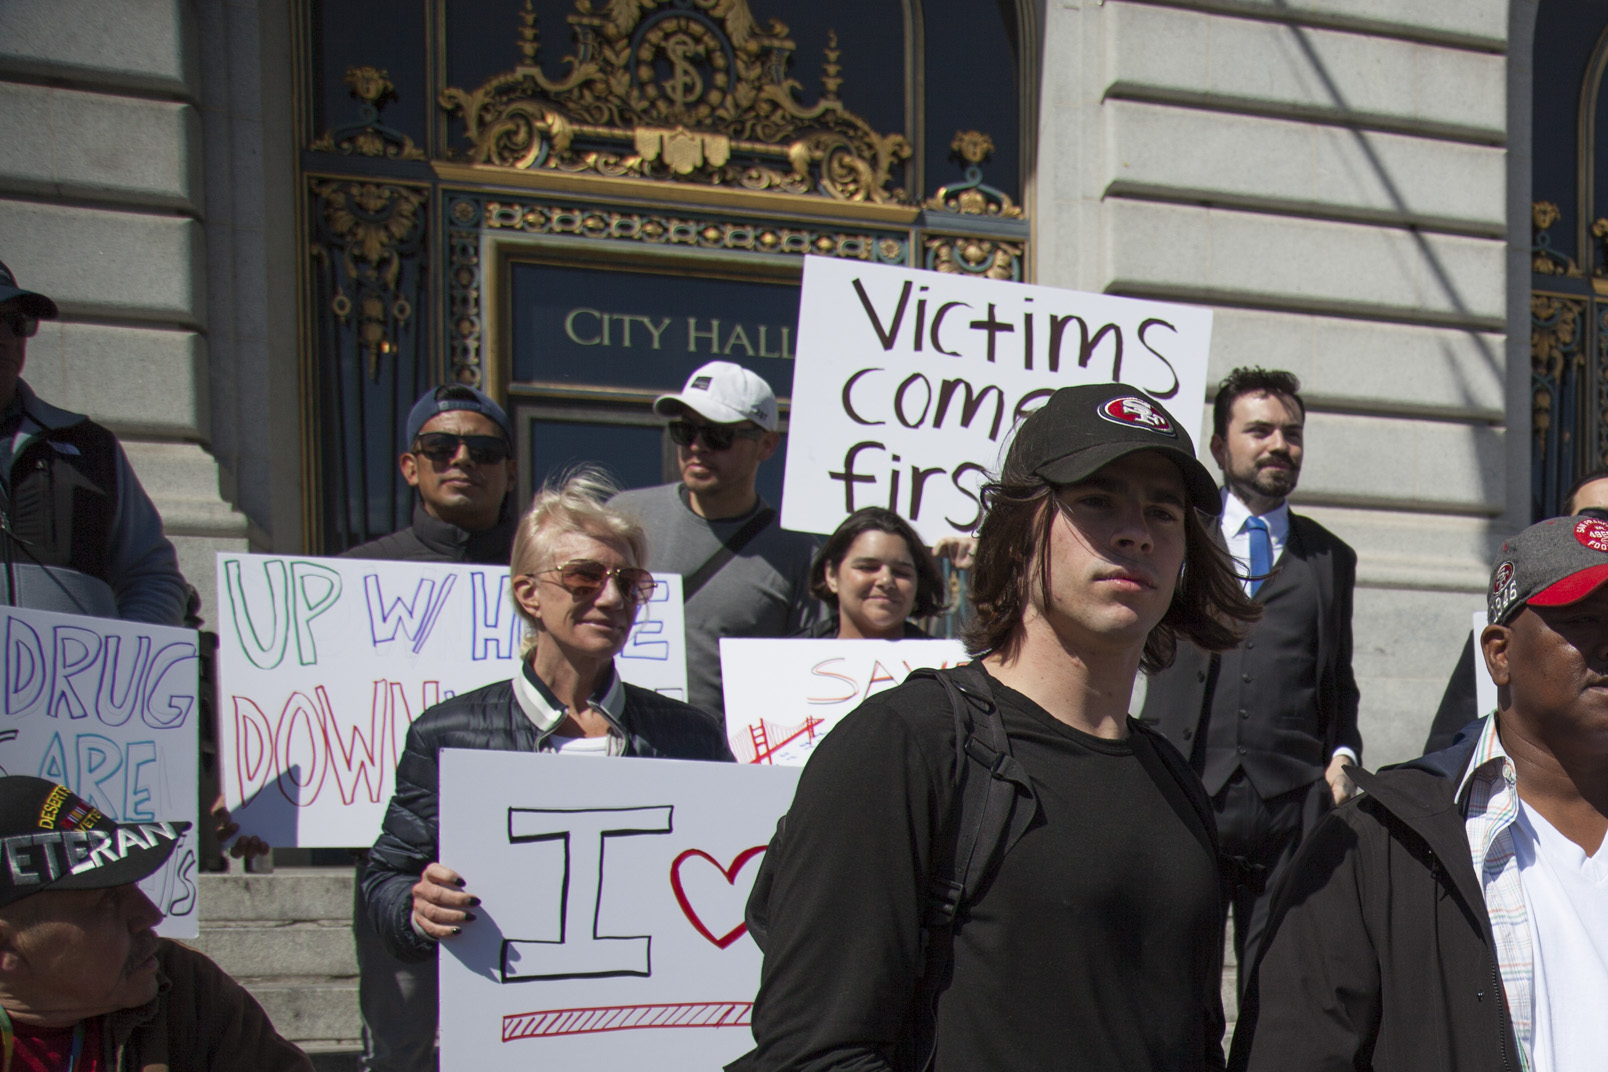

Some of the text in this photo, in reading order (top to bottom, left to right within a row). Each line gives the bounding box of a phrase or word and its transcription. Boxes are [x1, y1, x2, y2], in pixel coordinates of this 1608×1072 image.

[564, 307, 796, 360] CITY HALL
[851, 277, 1180, 400] Victims
[828, 440, 988, 532] firs
[225, 560, 342, 669] UP
[6, 616, 199, 729] DRUG
[806, 657, 972, 704] SA
[38, 731, 156, 823] ARE
[0, 822, 179, 885] ETERAN
[501, 805, 674, 983] I
